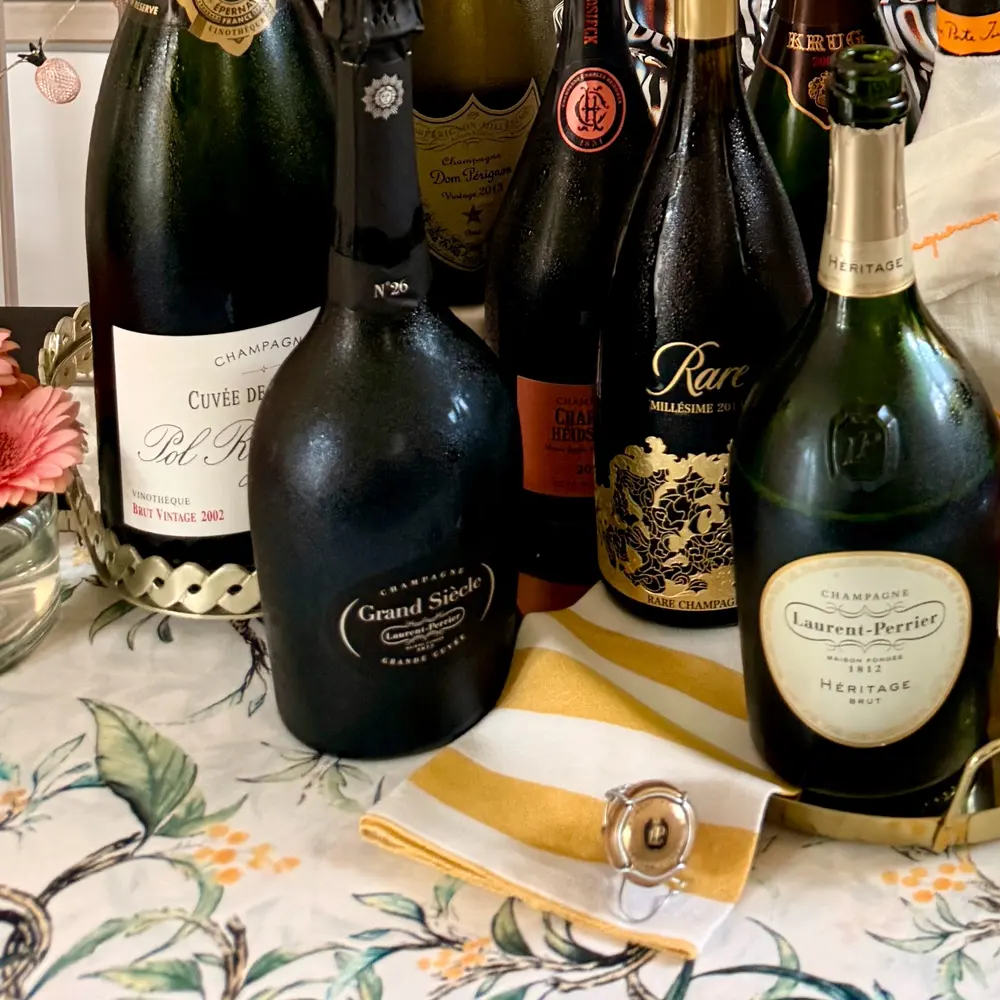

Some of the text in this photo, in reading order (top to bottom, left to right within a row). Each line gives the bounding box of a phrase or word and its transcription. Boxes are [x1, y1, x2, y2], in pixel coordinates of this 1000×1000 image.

[786, 28, 867, 53] KRUG
[429, 169, 461, 185] Dom
[828, 255, 904, 275] HÉRITAGE
[214, 335, 303, 368] CHAMPAGN
[645, 340, 750, 398] Rare
[188, 384, 266, 411] CUVÉE DE
[649, 399, 736, 414] MILLÉSIME 201
[137, 423, 212, 466] Pol
[132, 502, 225, 523] BRUT VINTAGE 2002
[380, 566, 466, 597] CHAMPAGNE
[358, 576, 483, 622] Grand Siècle
[647, 594, 735, 610] RARE CHAMPAG
[820, 588, 910, 601] CHAMPAGNE
[385, 612, 462, 641] Laurent-Perrier
[792, 611, 939, 637] Laurent-Perrier
[381, 655, 428, 666] GRANDE
[826, 655, 863, 663] MAISON
[848, 664, 883, 674] 1812
[820, 677, 912, 694] HÉRITAGE
[849, 697, 882, 705] BRUT
